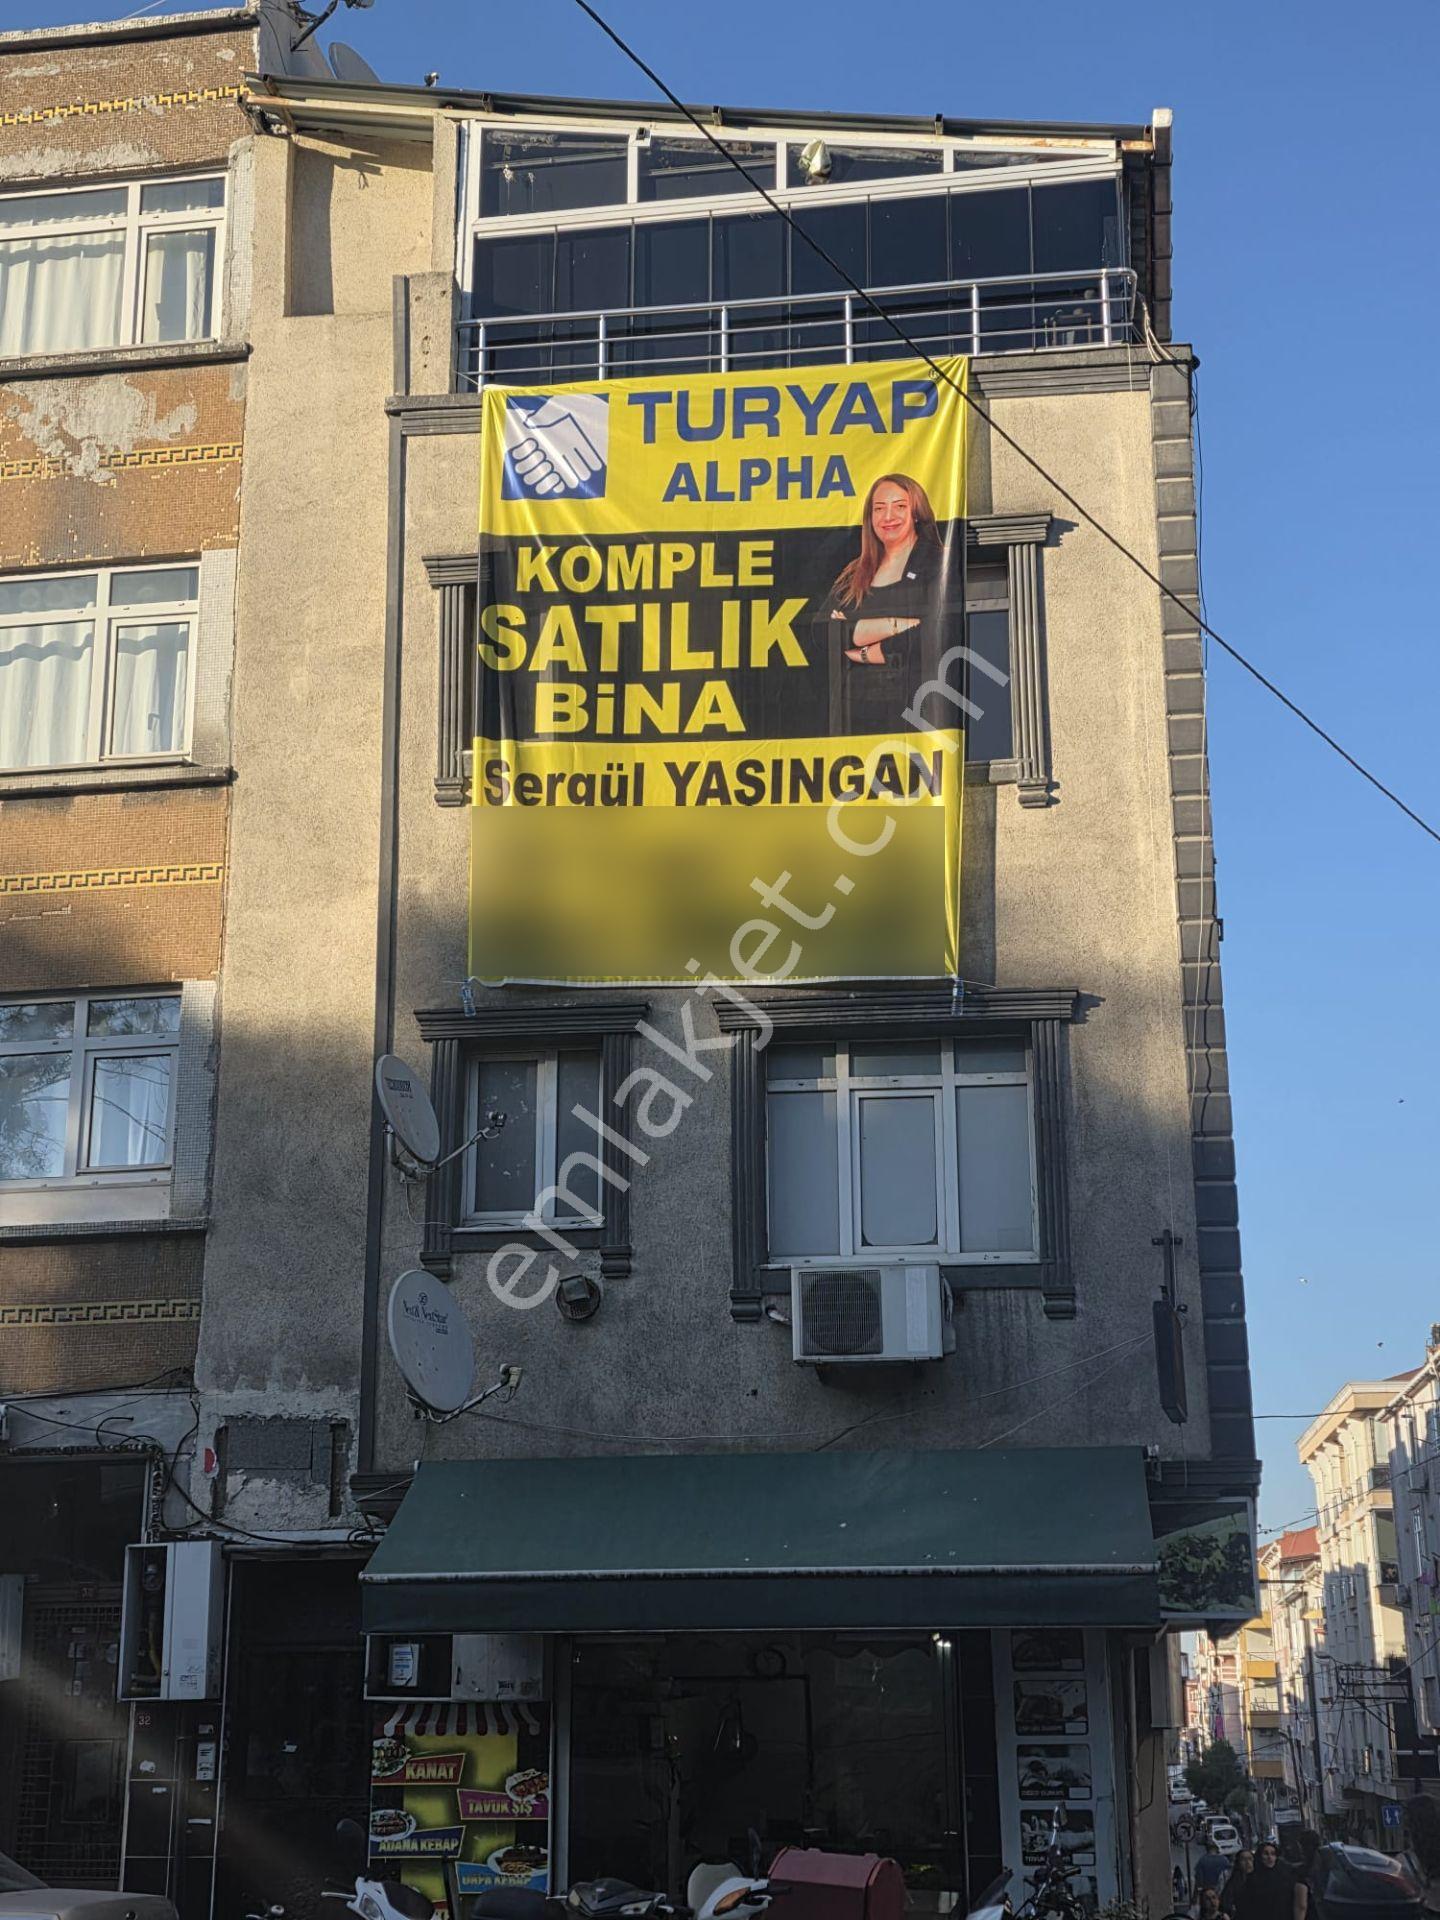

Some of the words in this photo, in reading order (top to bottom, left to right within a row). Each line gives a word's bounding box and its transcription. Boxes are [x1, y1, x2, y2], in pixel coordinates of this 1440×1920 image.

[628, 381, 939, 444] TURYAP
[662, 455, 856, 502] ALPHA
[516, 540, 775, 593] KOMPLE
[477, 598, 810, 673] SATILIK
[138, 1715, 151, 1726] 32
[405, 1762, 455, 1780] KANAT
[467, 1800, 509, 1814] TAVUK
[420, 1837, 459, 1851] KEBAP
